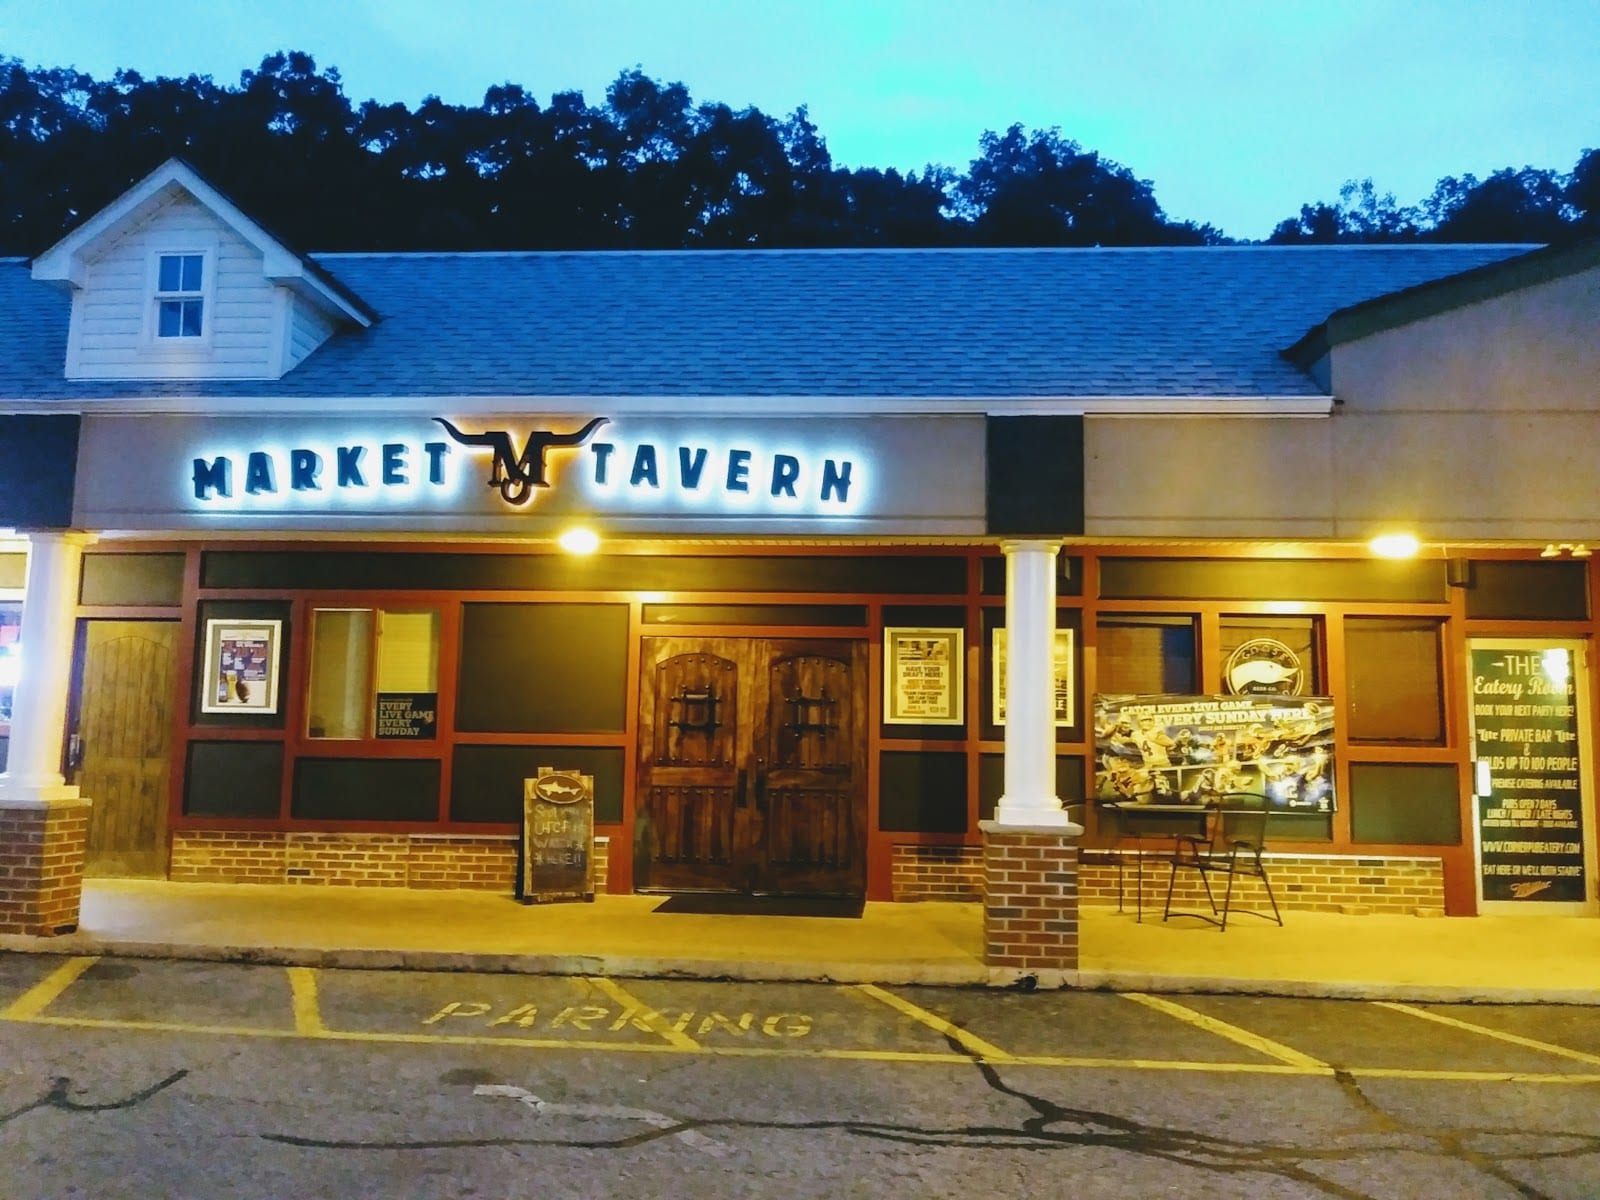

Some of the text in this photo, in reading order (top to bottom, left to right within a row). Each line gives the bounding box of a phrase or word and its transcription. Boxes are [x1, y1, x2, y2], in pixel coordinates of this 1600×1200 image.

[192, 443, 852, 503] MARKET TAVERN
[1504, 655, 1540, 676] THE
[1474, 676, 1524, 700] Eatery
[380, 702, 412, 710] EVERY
[1157, 703, 1196, 714] EVERY
[1197, 701, 1219, 713] LIVE
[1220, 701, 1253, 711] GAME
[1514, 705, 1531, 716] NEXT
[380, 711, 402, 719] LIVE
[1154, 713, 1202, 726] EVERY
[1205, 710, 1266, 724] SUNDAY
[379, 719, 412, 728] EVERY
[379, 727, 420, 736] SUNDAY
[1500, 729, 1534, 742] PRIVATE
[1535, 729, 1552, 742] BAR
[1506, 756, 1518, 769] UP
[1519, 757, 1530, 769] TO
[1546, 757, 1577, 771] PEOPLE
[422, 1002, 814, 1038] PARKING
